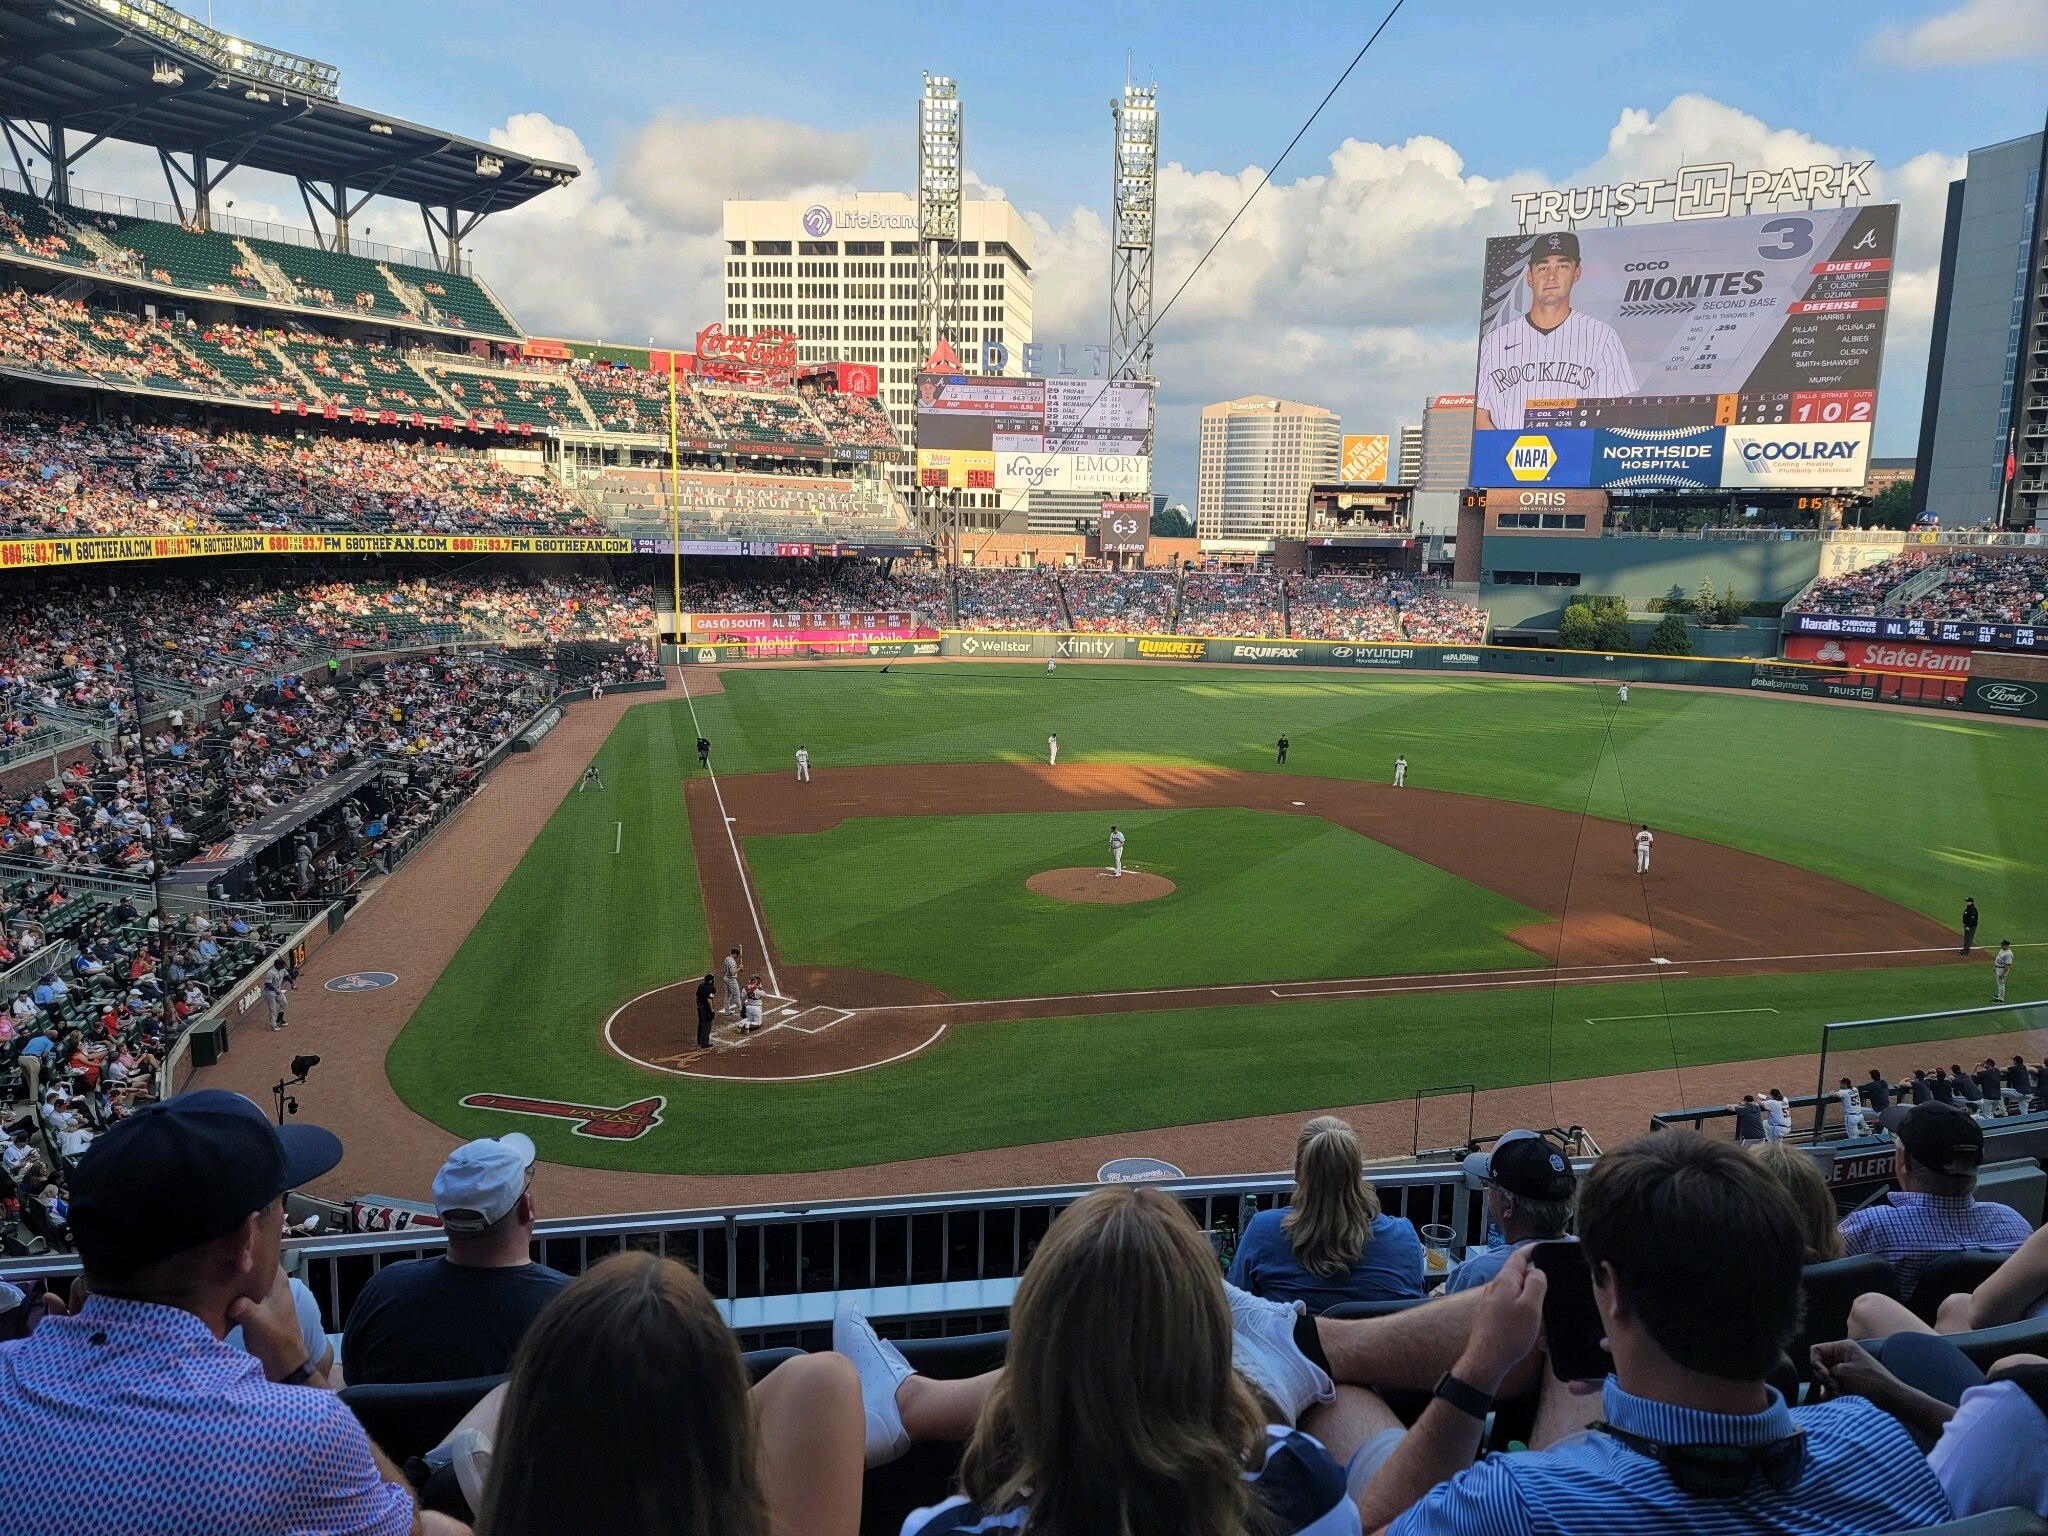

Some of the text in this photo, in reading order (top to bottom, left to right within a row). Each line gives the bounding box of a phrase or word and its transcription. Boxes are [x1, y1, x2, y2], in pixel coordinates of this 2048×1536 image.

[1512, 160, 1875, 225] TRUIST PARK
[1757, 217, 1815, 261] 3
[1624, 261, 1669, 272] COCO
[1826, 261, 1871, 272] DUE UP
[1836, 272, 1869, 281] MURPHY
[1623, 270, 1766, 303] MONTES
[1830, 281, 1858, 290] OLSON
[1824, 291, 1851, 299] OZUNA
[1703, 297, 1778, 310] SECOND BASE
[1802, 300, 1859, 312] DEFENSE
[1816, 313, 1845, 321] HARRIS
[1836, 323, 1864, 332] ACUÑA
[1841, 335, 1869, 343] ALBIES
[696, 322, 800, 369] Coca-Cola
[1840, 348, 1868, 356] OLSON
[1795, 359, 1860, 368] SMITH-SHAWVER
[949, 376, 967, 385] 62
[1490, 362, 1595, 393] ROCKIES
[1809, 376, 1842, 384] MURPHY
[1231, 401, 1264, 411] Travelport
[1438, 396, 1475, 405] RaceTrac
[1798, 402, 1871, 422] 1 0 2
[691, 440, 707, 448] Coke
[708, 441, 728, 449] Ever?
[735, 443, 751, 451] Coke
[1347, 440, 1366, 458] THE
[1743, 440, 1861, 460] COOLRAY
[834, 449, 851, 459] 7:40
[1341, 435, 1389, 481] HOME
[1514, 448, 1549, 468] NAPA
[1603, 445, 1713, 459] NORTHSIDE
[1076, 455, 1144, 472] EMORY
[1358, 452, 1388, 481] DEPOT
[1621, 460, 1690, 469] HOSPITAL
[1007, 455, 1060, 486] Kroger
[1519, 492, 1566, 506] ORIS
[1113, 520, 1138, 534] 6-3
[155, 536, 265, 556] 680 THE 680THEFAN.COM
[269, 537, 289, 550] 680
[345, 536, 448, 551] 680THEFAN.COM
[453, 539, 473, 550] 680
[535, 540, 629, 551] 680THEFAN.COM
[1119, 543, 1145, 551] ALFARO
[2, 538, 152, 565] 680 THE 680THEFAN.COM
[697, 618, 765, 629] GAS SOUTH
[772, 618, 785, 628] AL
[1801, 617, 1877, 631] Harrah's CHEROKEE
[1887, 623, 1904, 635] NL
[1944, 624, 1958, 632] PIT
[1908, 627, 1925, 635] ARZ
[1943, 632, 1960, 640] CHC
[1980, 626, 1996, 635] CLE
[2017, 629, 2034, 637] CWS
[981, 640, 1031, 652] Wellstar
[1057, 637, 1115, 657] xfinity
[1234, 645, 1300, 660] EQUIFAX
[1356, 648, 1413, 659] HYUNDAI
[1828, 686, 1861, 696] TRUIST
[1987, 685, 2026, 703] Ford
[1846, 1156, 1896, 1180] ALERT
